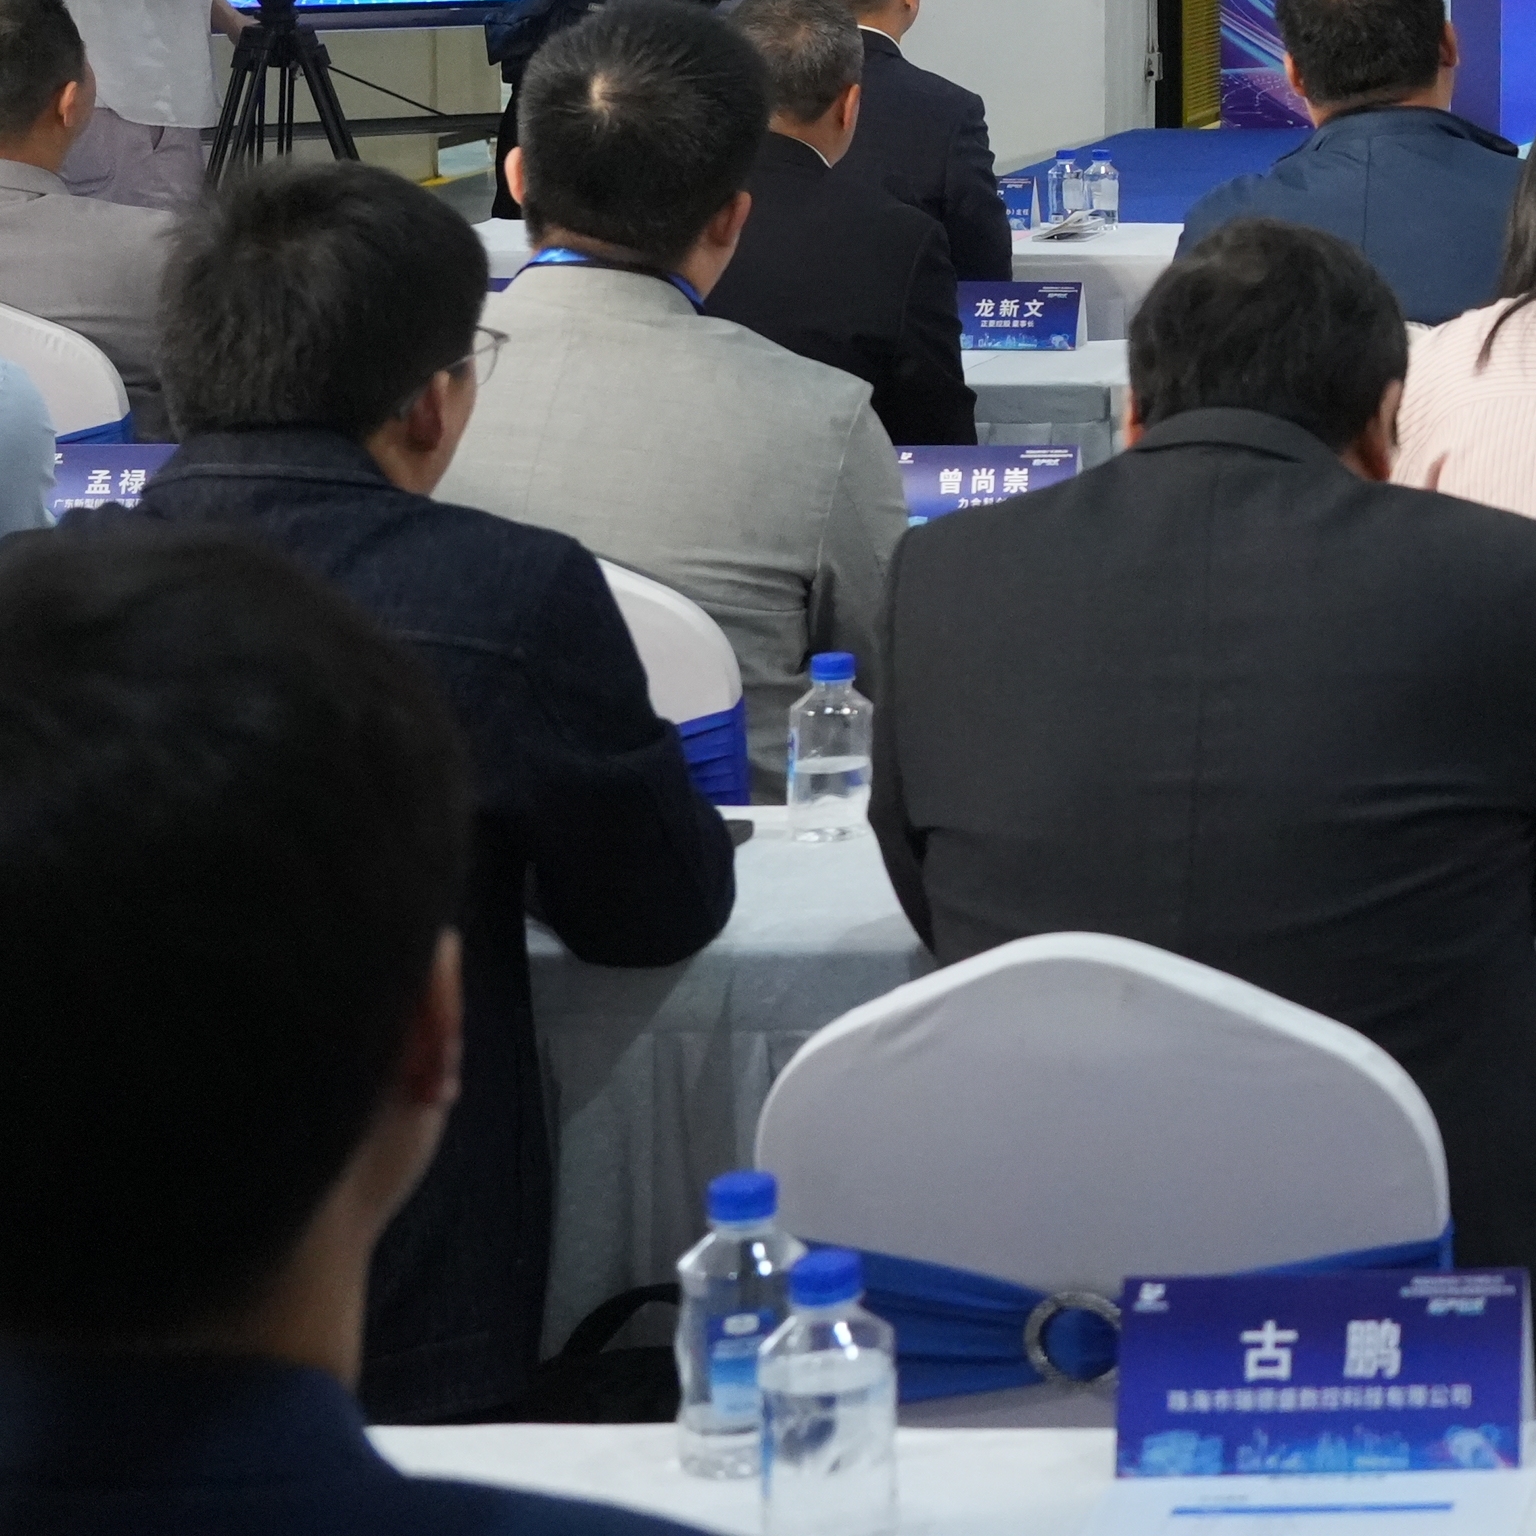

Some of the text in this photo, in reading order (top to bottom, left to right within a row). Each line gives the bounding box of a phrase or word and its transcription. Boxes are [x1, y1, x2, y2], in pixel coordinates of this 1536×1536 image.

[974, 298, 1045, 318] 龙新文
[939, 467, 1029, 495] 曾尚崇
